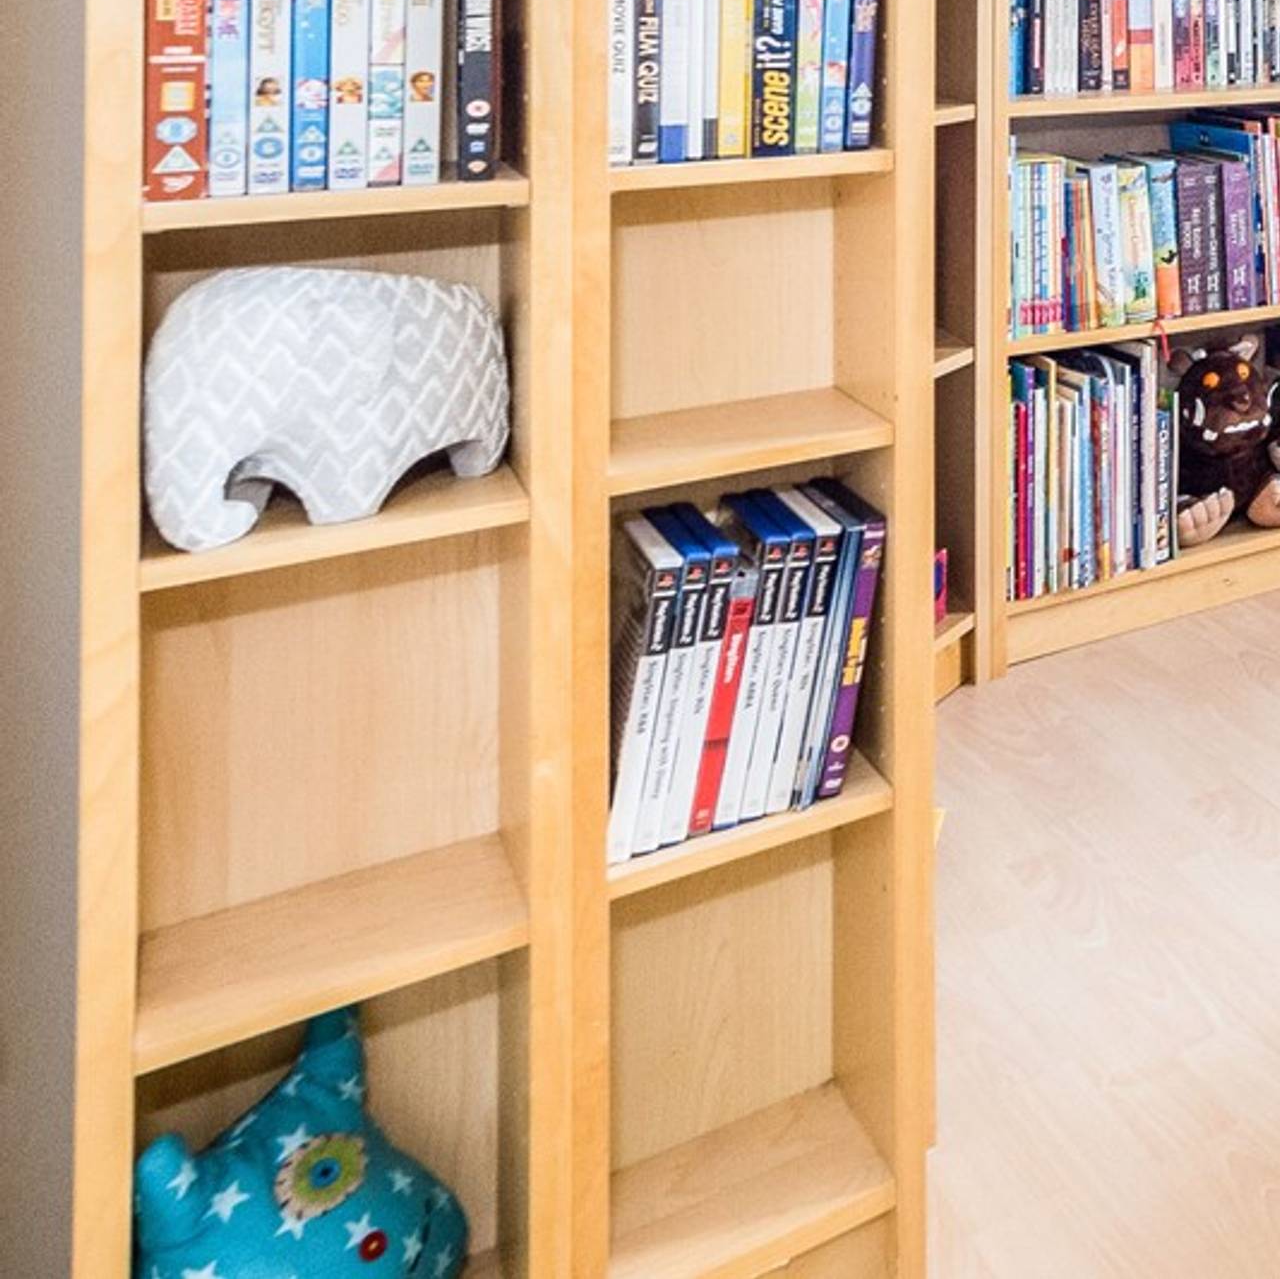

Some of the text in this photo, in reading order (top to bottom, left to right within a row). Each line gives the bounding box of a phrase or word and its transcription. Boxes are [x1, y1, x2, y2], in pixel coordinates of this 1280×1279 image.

[465, 16, 491, 52] WICK
[638, 17, 660, 56] FILM
[613, 41, 626, 74] QUIZ
[638, 61, 660, 103] QUIZ
[755, 36, 792, 146] scene it?
